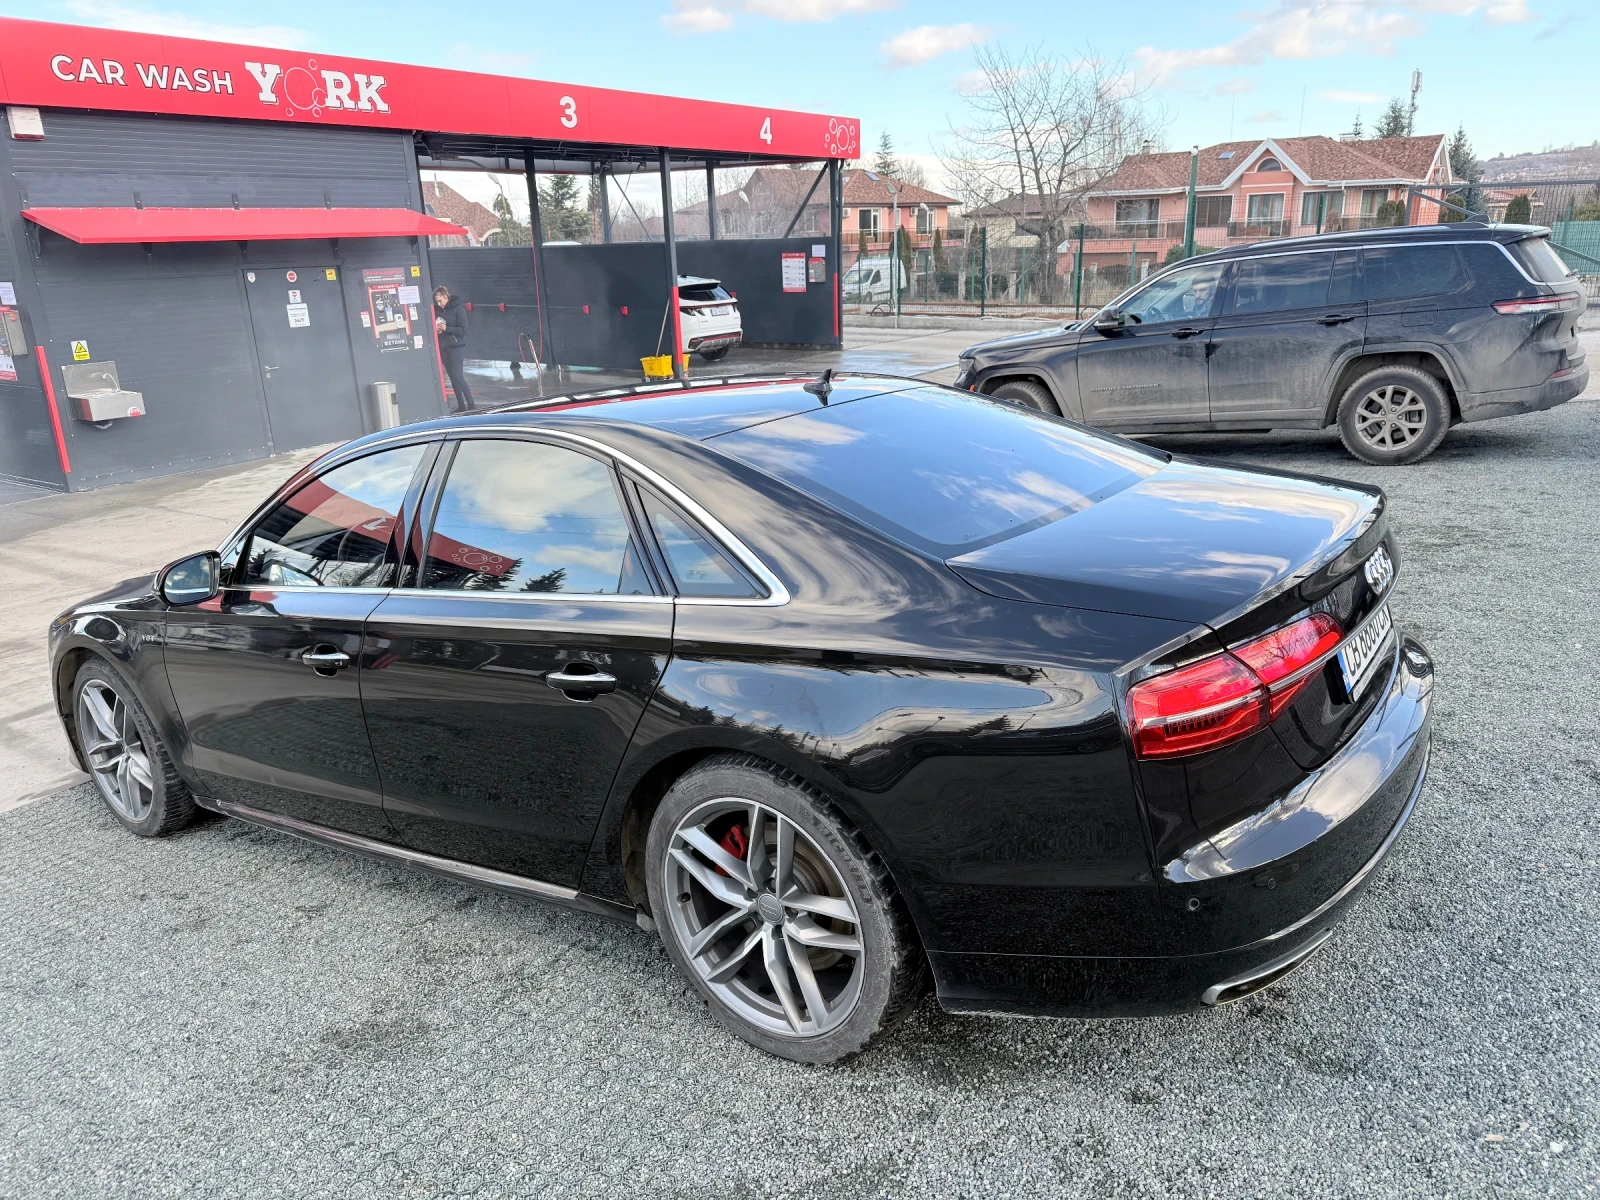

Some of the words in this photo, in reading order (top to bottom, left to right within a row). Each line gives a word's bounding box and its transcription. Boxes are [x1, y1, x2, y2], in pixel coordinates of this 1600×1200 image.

[50, 54, 128, 87] CAR
[134, 62, 235, 95] WASH
[244, 60, 391, 114] YORK
[559, 96, 578, 128] 3
[760, 117, 773, 144] 4
